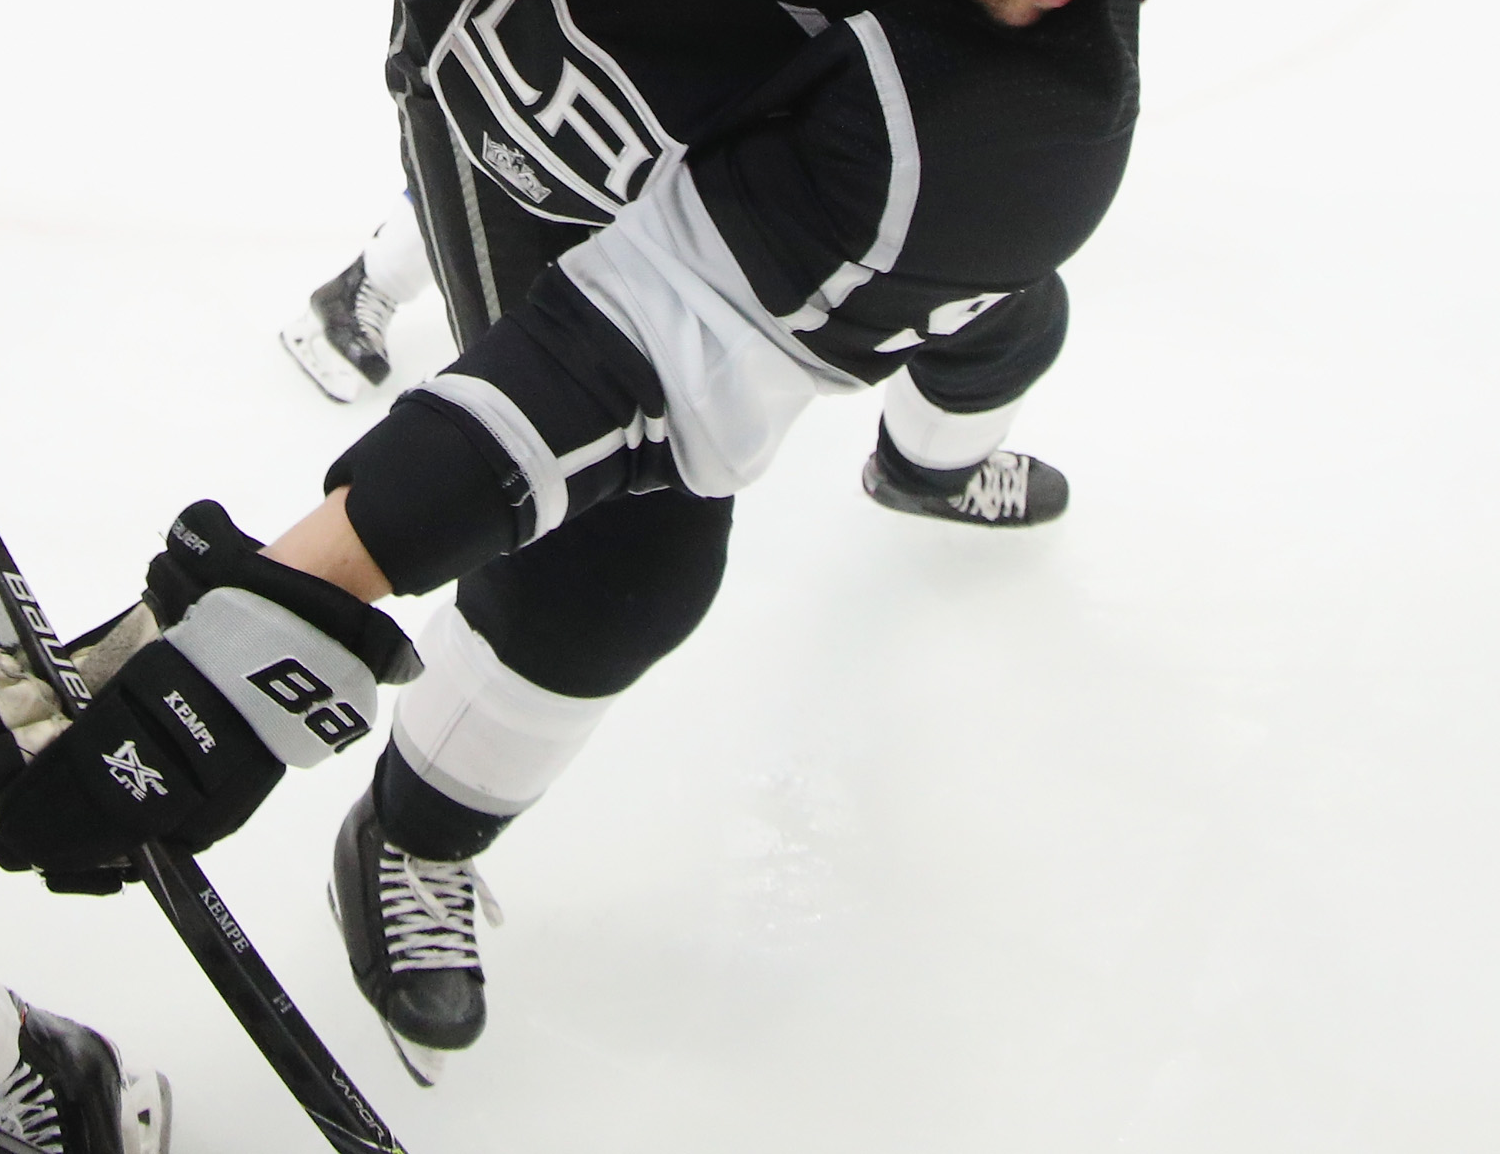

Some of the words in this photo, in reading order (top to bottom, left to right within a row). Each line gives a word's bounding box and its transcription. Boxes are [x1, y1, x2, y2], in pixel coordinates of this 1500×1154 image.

[2, 571, 93, 710] BAUE
[162, 690, 217, 754] KEMPE
[243, 657, 373, 755] BA
[199, 887, 250, 955] KEMPE
[331, 1067, 386, 1140] VAPOR
